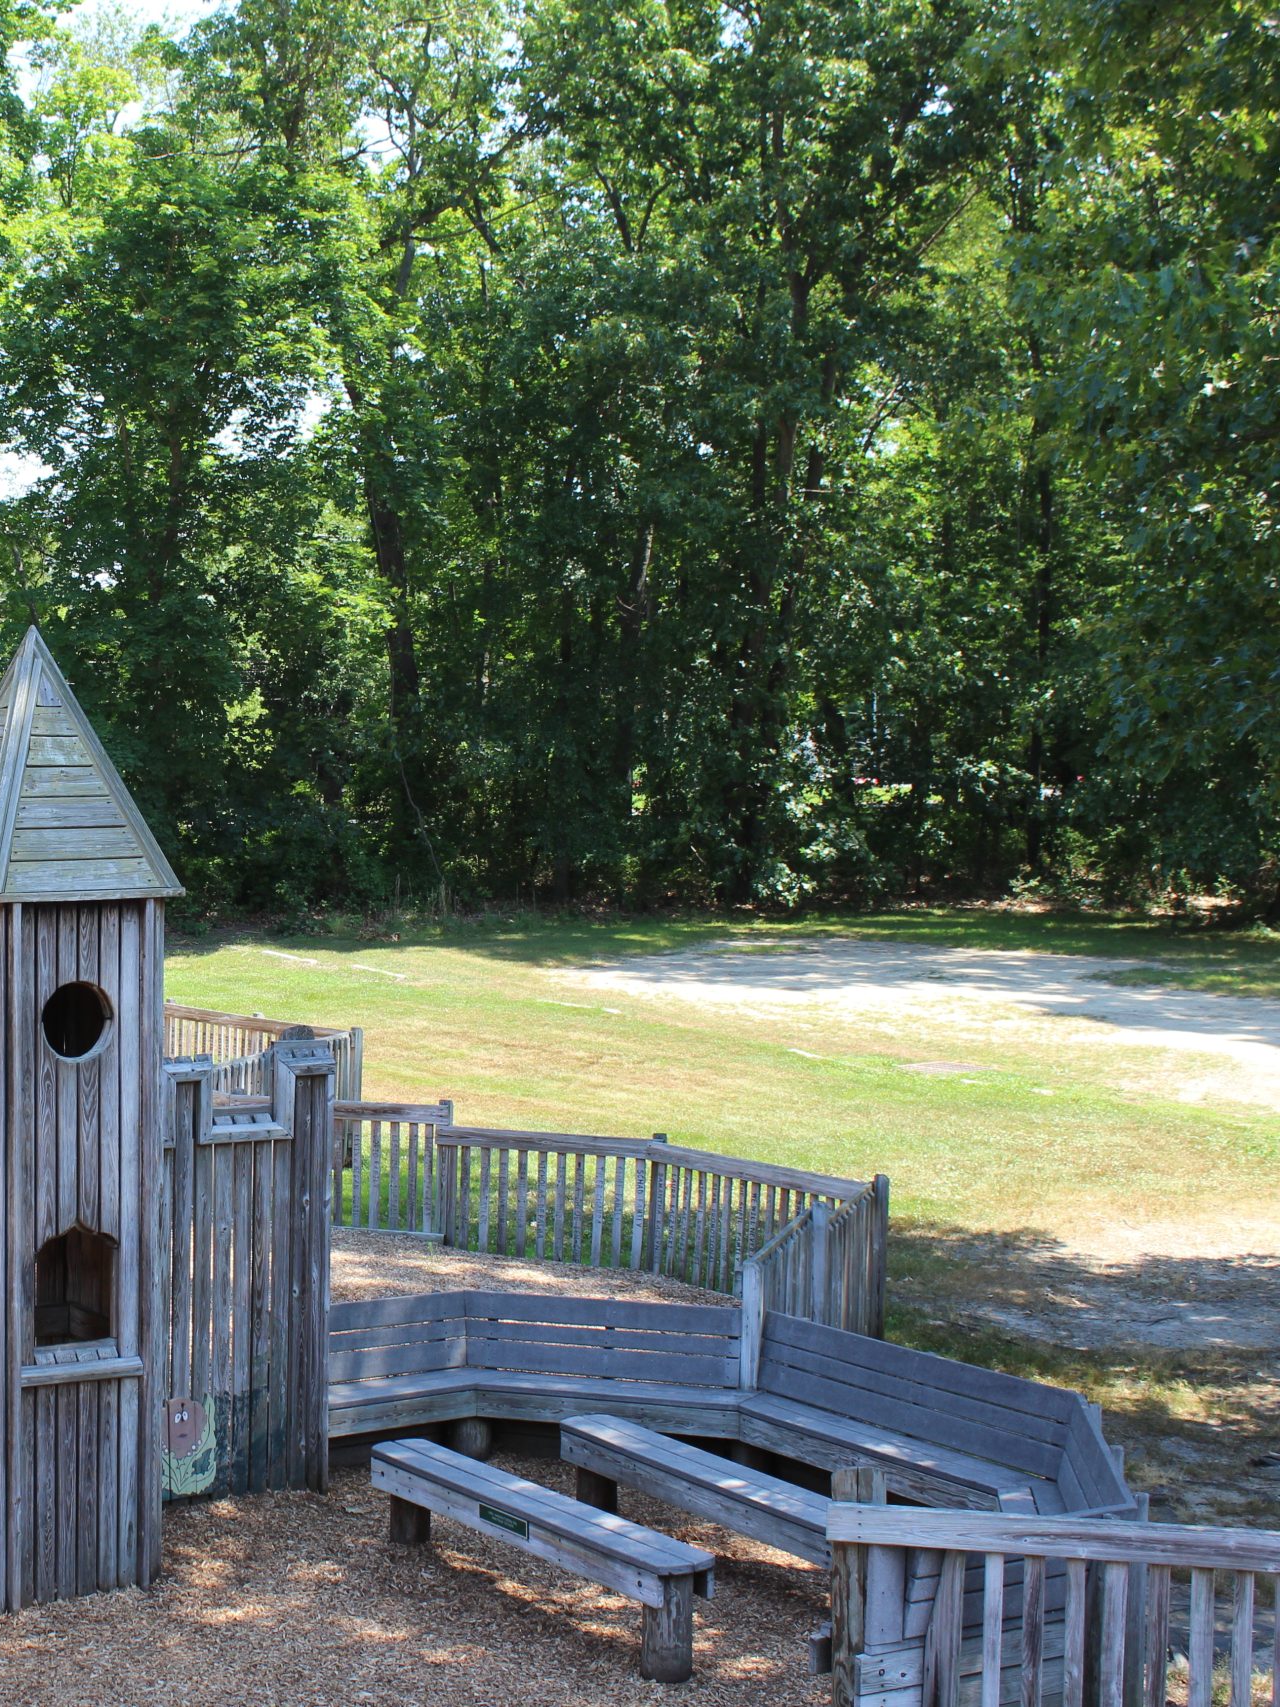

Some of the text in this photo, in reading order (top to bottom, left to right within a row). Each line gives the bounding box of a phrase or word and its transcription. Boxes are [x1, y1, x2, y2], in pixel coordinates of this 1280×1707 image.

[538, 1160, 546, 1198] NICHOLAS
[751, 1192, 757, 1202] WE
[735, 1232, 743, 1262] FAMILY
